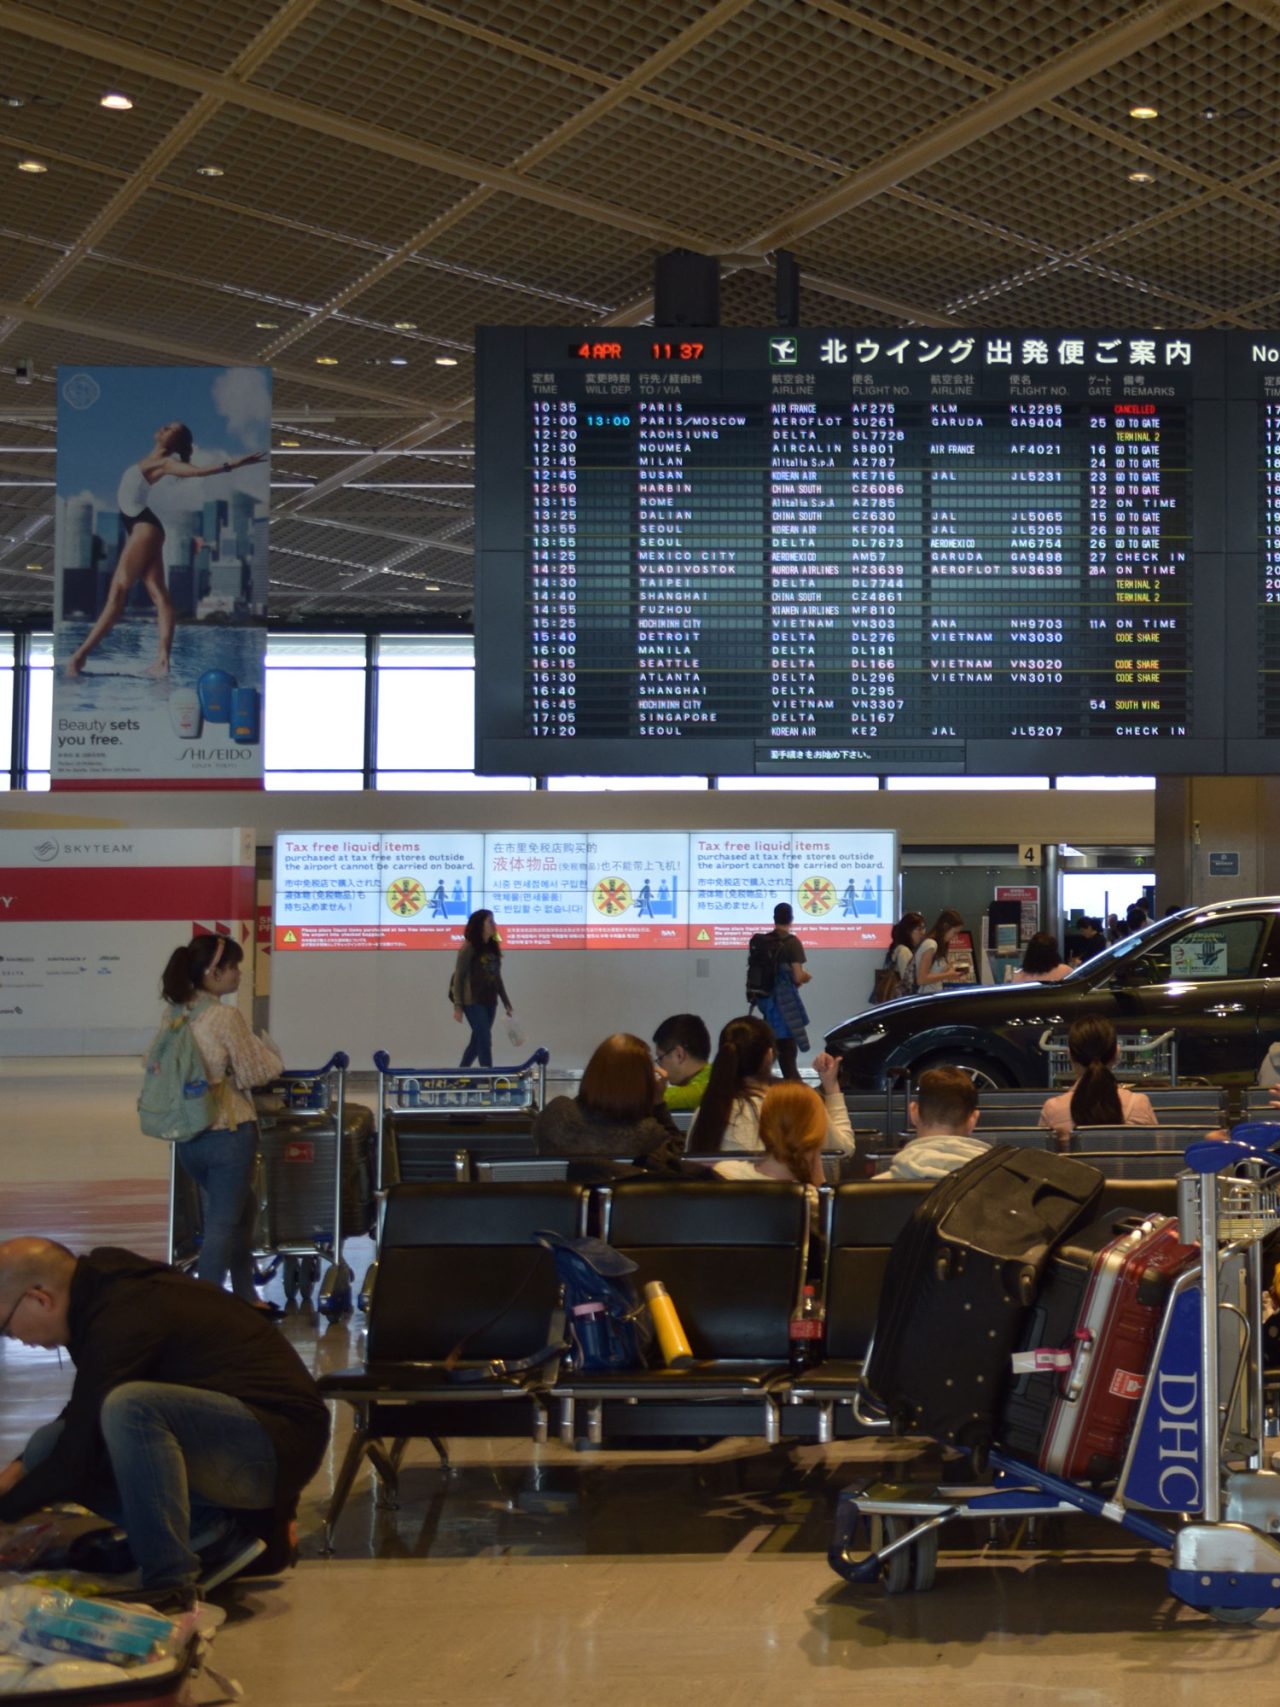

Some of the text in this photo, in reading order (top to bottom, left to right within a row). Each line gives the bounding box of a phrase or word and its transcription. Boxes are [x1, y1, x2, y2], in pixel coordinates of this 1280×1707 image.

[533, 386, 557, 395] TIME
[586, 386, 606, 395] WILL
[772, 386, 814, 395] AIRLINE
[1089, 387, 1111, 396] GATE
[1123, 387, 1175, 396] REMARKS
[535, 403, 576, 412] 10:35
[640, 403, 682, 412] PARIS
[772, 404, 786, 413] AIR
[853, 404, 894, 413] AF275
[931, 405, 957, 413] KLM
[1011, 405, 1062, 414] KL2295
[535, 416, 576, 425] 12:00
[588, 416, 630, 425] 13:00
[640, 417, 745, 425] PARIS/MOSCOW
[774, 417, 841, 425] AEROFLOT
[853, 417, 893, 427] SU261
[932, 418, 983, 426] GARUDA
[1011, 418, 1061, 427] GA9404
[1091, 418, 1106, 428] 25
[535, 430, 904, 440] 12:20 KAOHSIUNG DELTA DL7728
[534, 551, 1184, 562] 14:25 MEXICO CITY AM57 GARUDA GA9498 27 CHECK IN
[534, 632, 1062, 642] 15:40 DETROIT DELTA DL276 VIETNAM VN3030
[59, 719, 139, 733] Beauty sets
[58, 734, 123, 747] you free.
[176, 747, 252, 760] SHISEIDO
[64, 844, 133, 853] SKYTEAM
[286, 842, 419, 852] Tax free liquid items
[698, 841, 830, 852] Tax free liquid items
[285, 854, 336, 863] purchased
[429, 853, 464, 861] outside
[698, 852, 747, 862] purchased
[838, 852, 874, 860] outside
[1024, 848, 1034, 862] 4
[303, 862, 336, 872] airport
[393, 862, 427, 870] carried
[716, 861, 749, 870] airport
[804, 861, 840, 869] carried
[855, 861, 884, 869] board.
[1159, 1371, 1199, 1504] DHC
